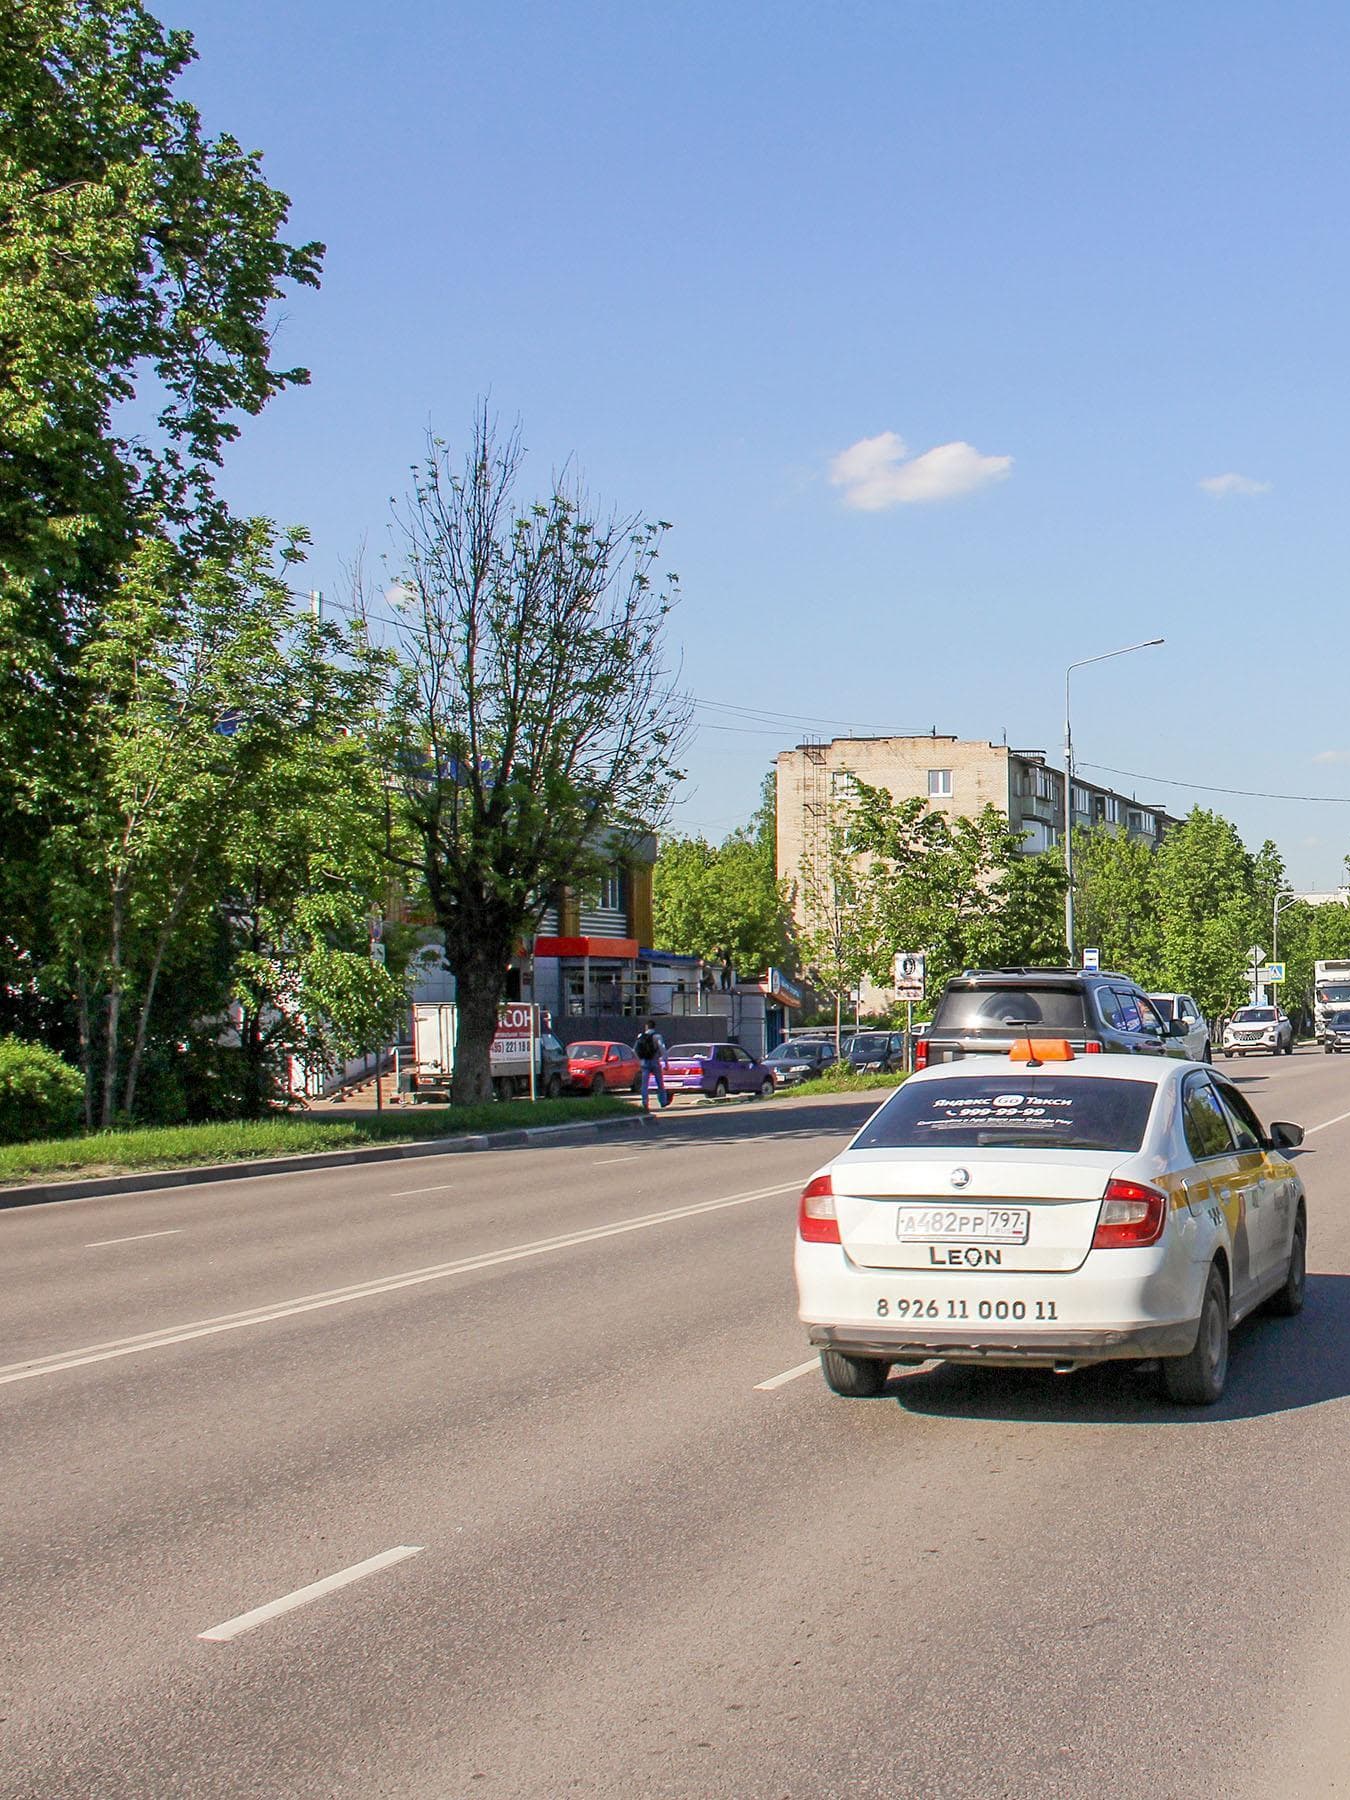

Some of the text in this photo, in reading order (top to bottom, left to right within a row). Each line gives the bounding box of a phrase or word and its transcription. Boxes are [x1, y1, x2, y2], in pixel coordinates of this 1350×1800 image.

[932, 1098, 992, 1108] Яндекс
[1026, 1096, 1073, 1106] Такси
[959, 1108, 1046, 1116] 999-99-99
[903, 1211, 1021, 1233] А482РР 797
[876, 1298, 1058, 1320] 8 926 11 000 11
